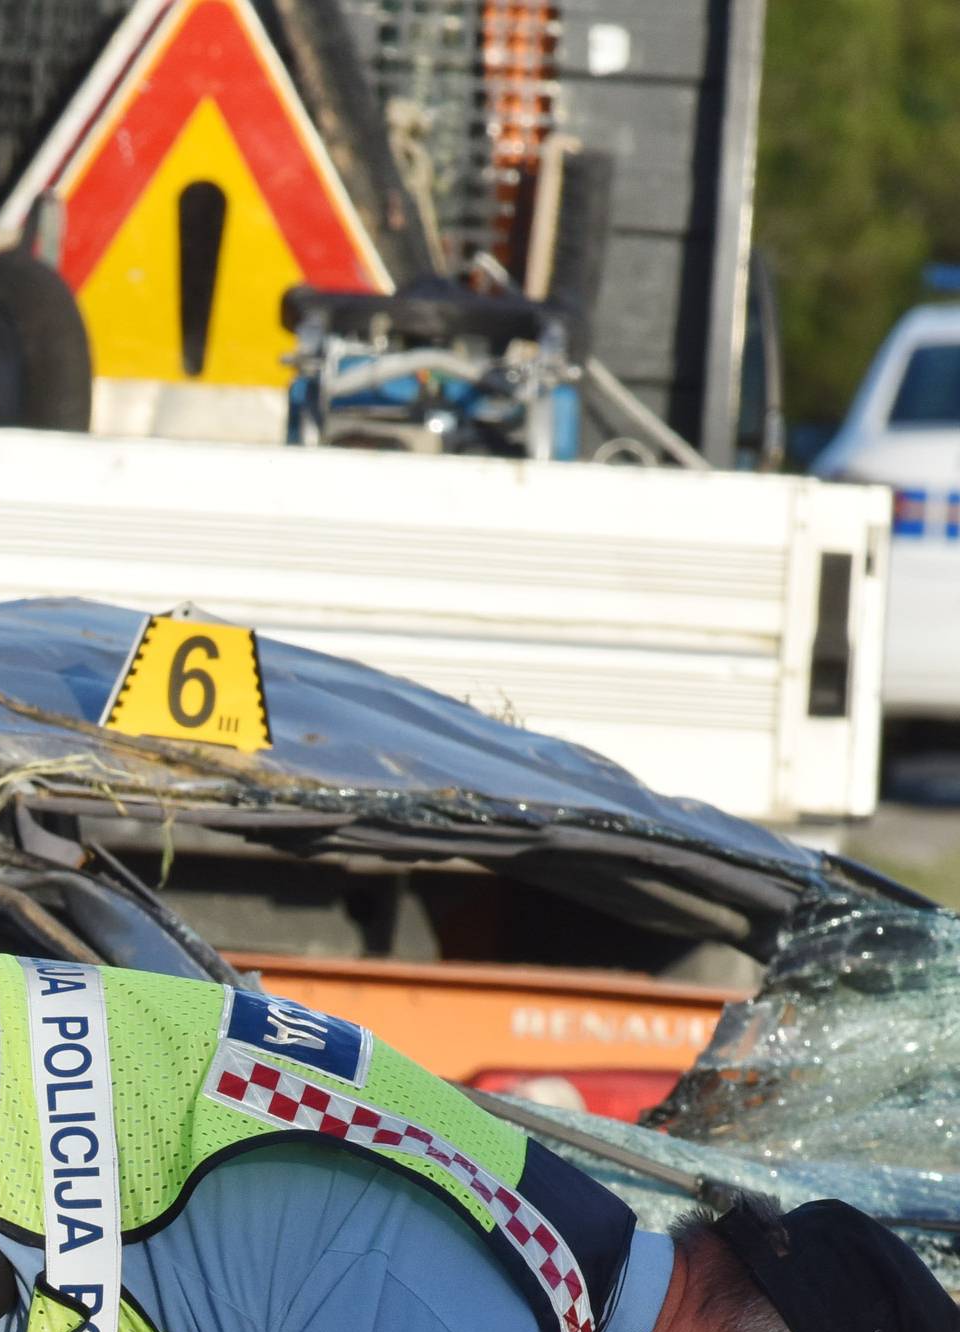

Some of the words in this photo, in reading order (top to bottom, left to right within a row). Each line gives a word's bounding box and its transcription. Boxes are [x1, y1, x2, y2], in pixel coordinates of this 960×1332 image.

[167, 635, 220, 729] 6
[510, 1007, 719, 1046] RENAUL
[42, 1015, 104, 1255] POLICIJA
